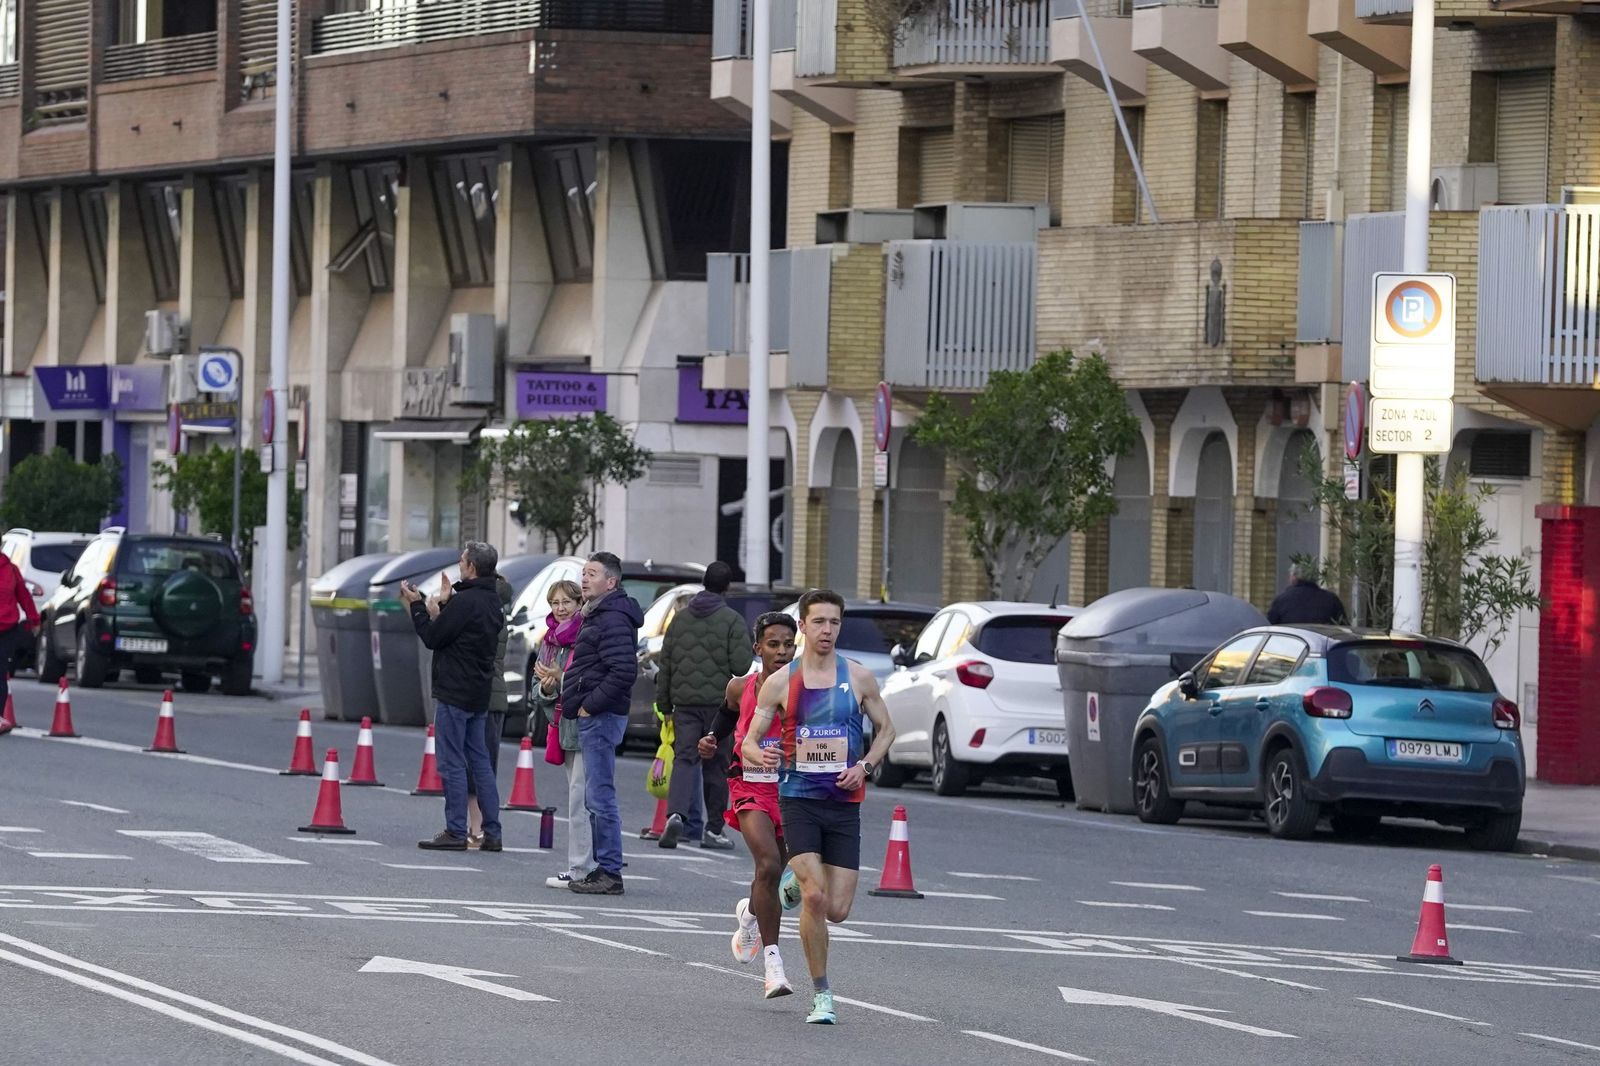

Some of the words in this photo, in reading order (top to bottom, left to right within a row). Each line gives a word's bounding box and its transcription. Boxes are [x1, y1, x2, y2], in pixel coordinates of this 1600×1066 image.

[526, 379, 581, 391] TATTOO
[586, 382, 597, 392] &
[526, 394, 598, 406] PIERCING
[1381, 408, 1407, 420] ZONA
[1413, 409, 1438, 421] AZUL
[1376, 430, 1412, 442] SECTOR
[1424, 429, 1432, 441] 2
[1399, 742, 1431, 755] 0979
[1435, 744, 1459, 757] LMJ
[807, 752, 836, 761] MILNE
[0, 891, 872, 936] XCEPT
